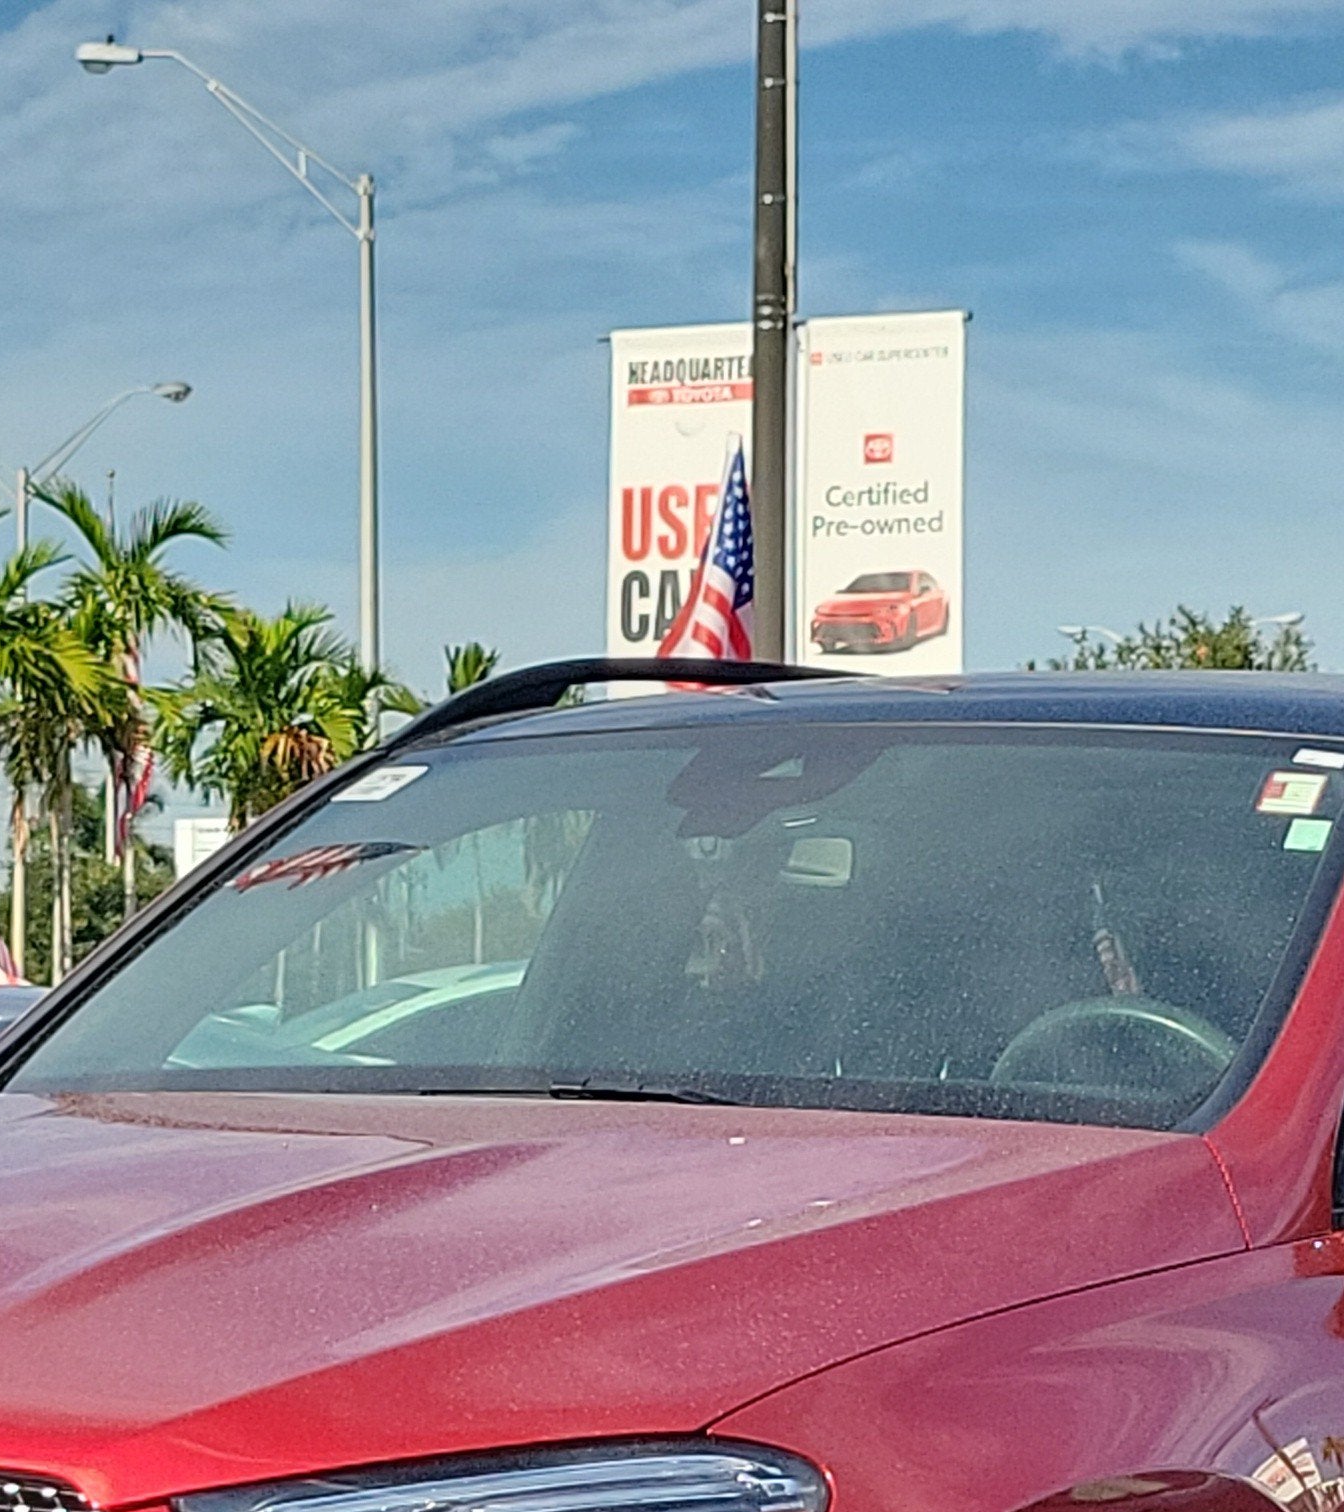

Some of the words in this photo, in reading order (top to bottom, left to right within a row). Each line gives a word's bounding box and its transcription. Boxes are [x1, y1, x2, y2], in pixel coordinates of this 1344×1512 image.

[628, 355, 754, 387] HEADQUARTE
[825, 481, 929, 507] Certified
[621, 483, 720, 562] USE
[812, 510, 944, 538] Pre-owned
